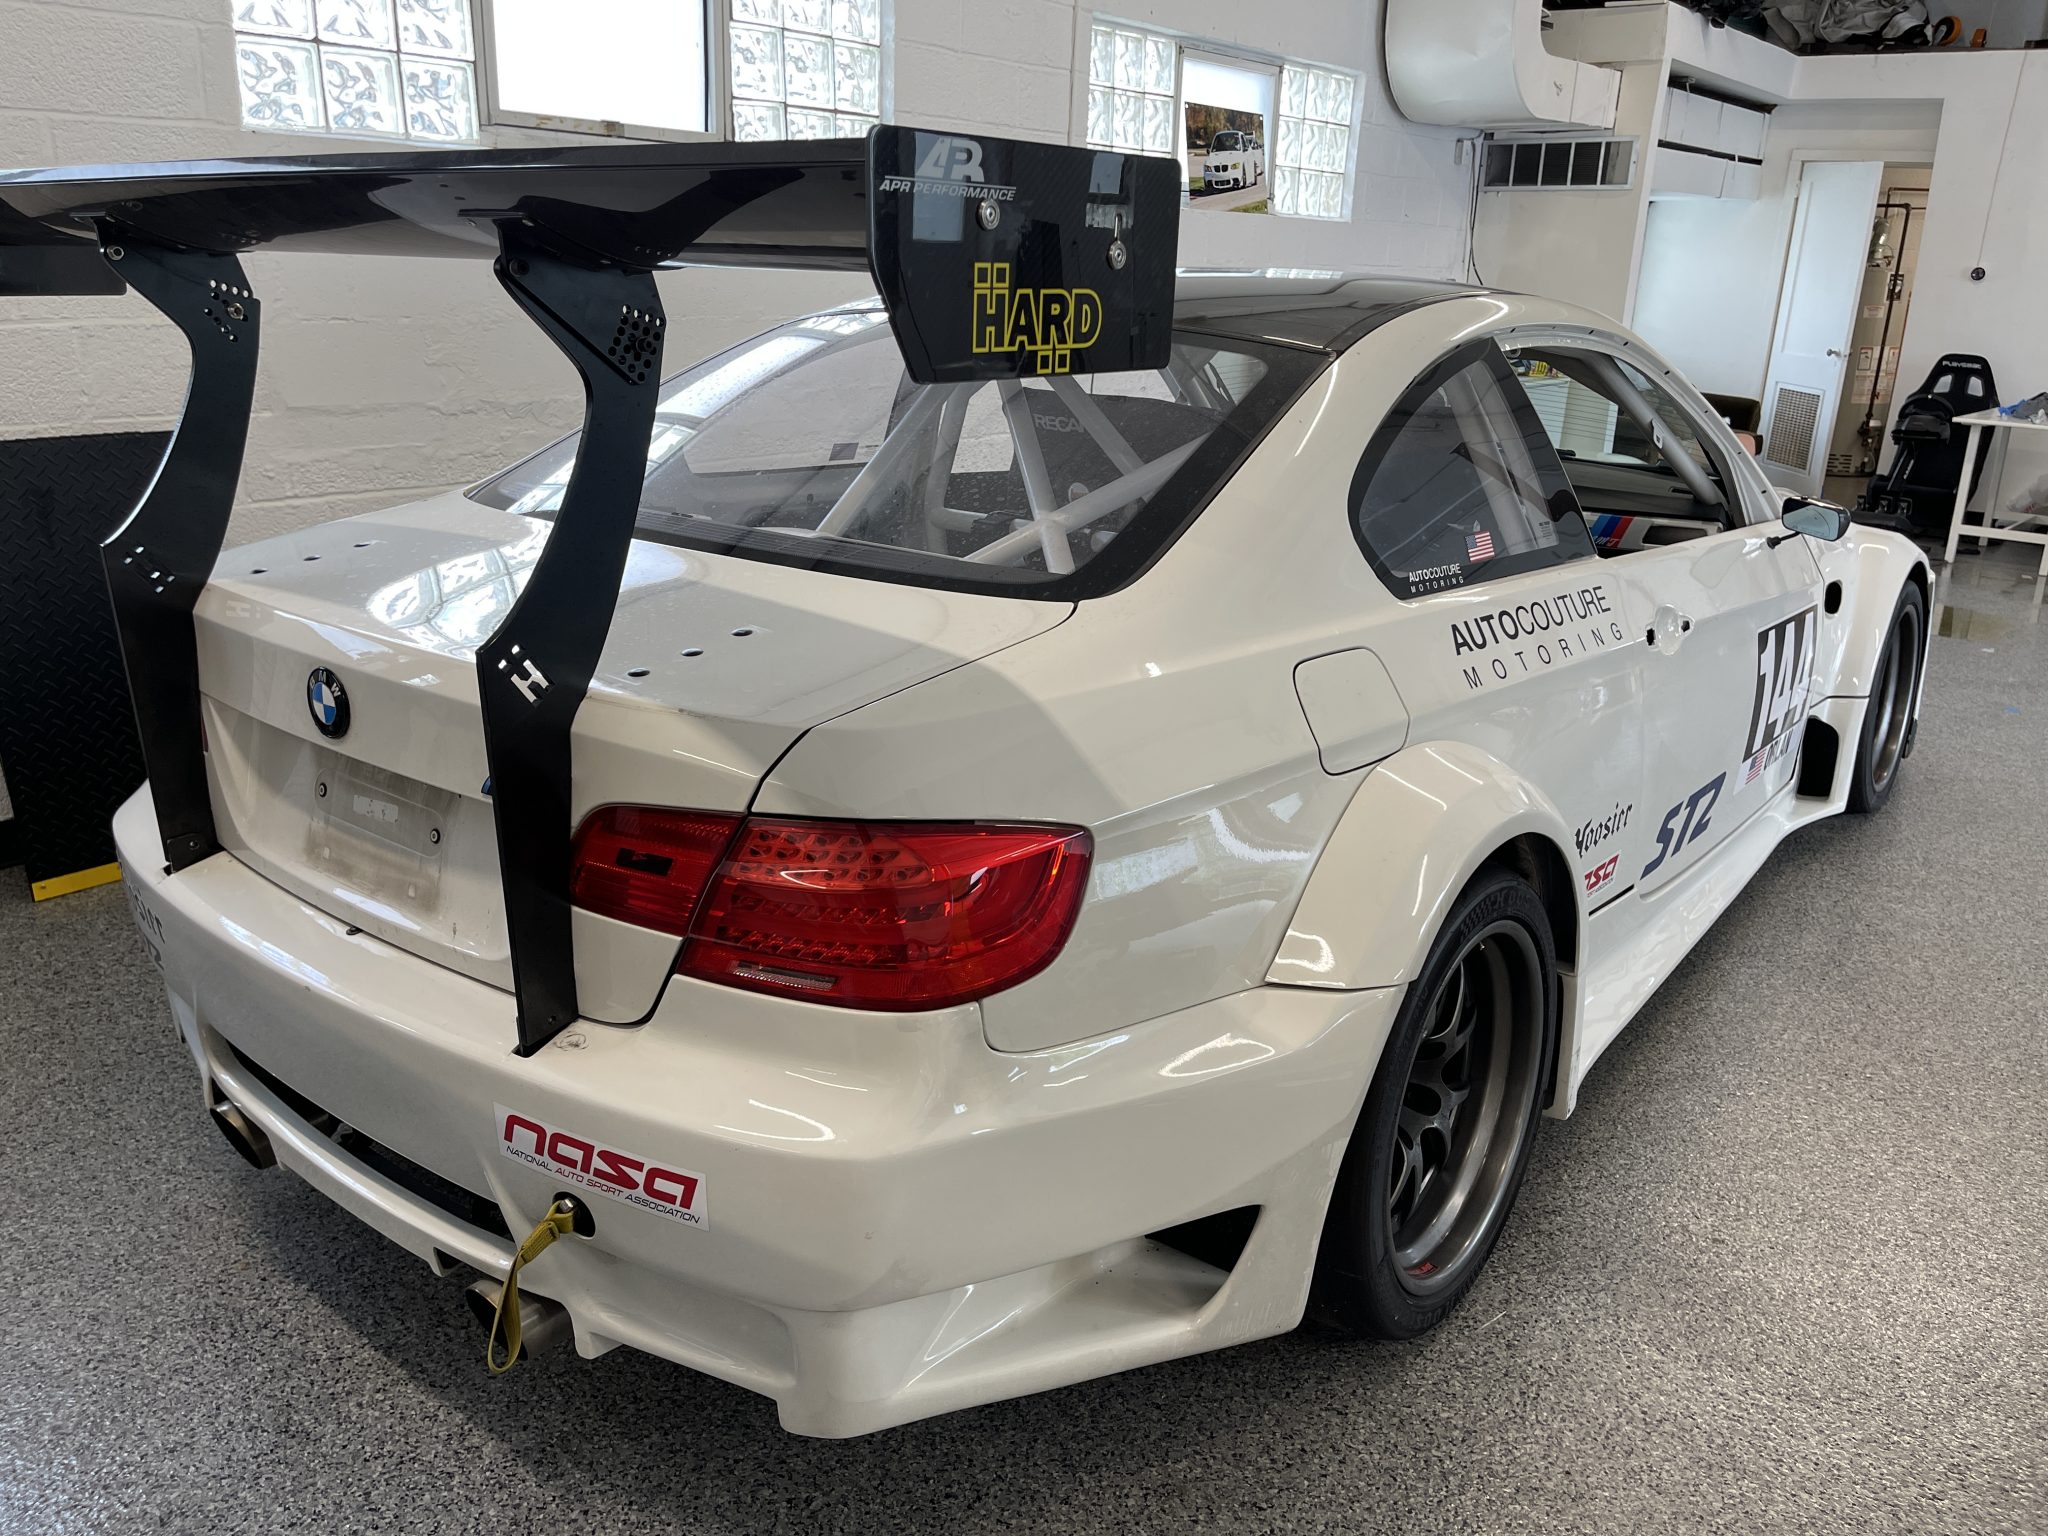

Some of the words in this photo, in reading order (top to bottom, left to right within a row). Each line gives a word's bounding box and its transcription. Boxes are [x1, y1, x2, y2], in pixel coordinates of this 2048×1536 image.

[879, 179, 911, 193] APR
[913, 181, 1017, 201] PERFORMANCE
[1032, 413, 1084, 433] RECA
[1408, 563, 1462, 584] AUTOCOUTURE
[1410, 576, 1464, 594] MOTORING
[1450, 585, 1612, 656] AUTOCOUTURE
[1462, 622, 1624, 690] MOTORING
[1752, 611, 1815, 755] 144
[503, 1114, 699, 1210] nasa
[506, 1145, 552, 1172] NATIONAL
[555, 1166, 584, 1183] AUTO
[586, 1178, 624, 1197] SPORT
[625, 1193, 701, 1225] ASSOCIATION
